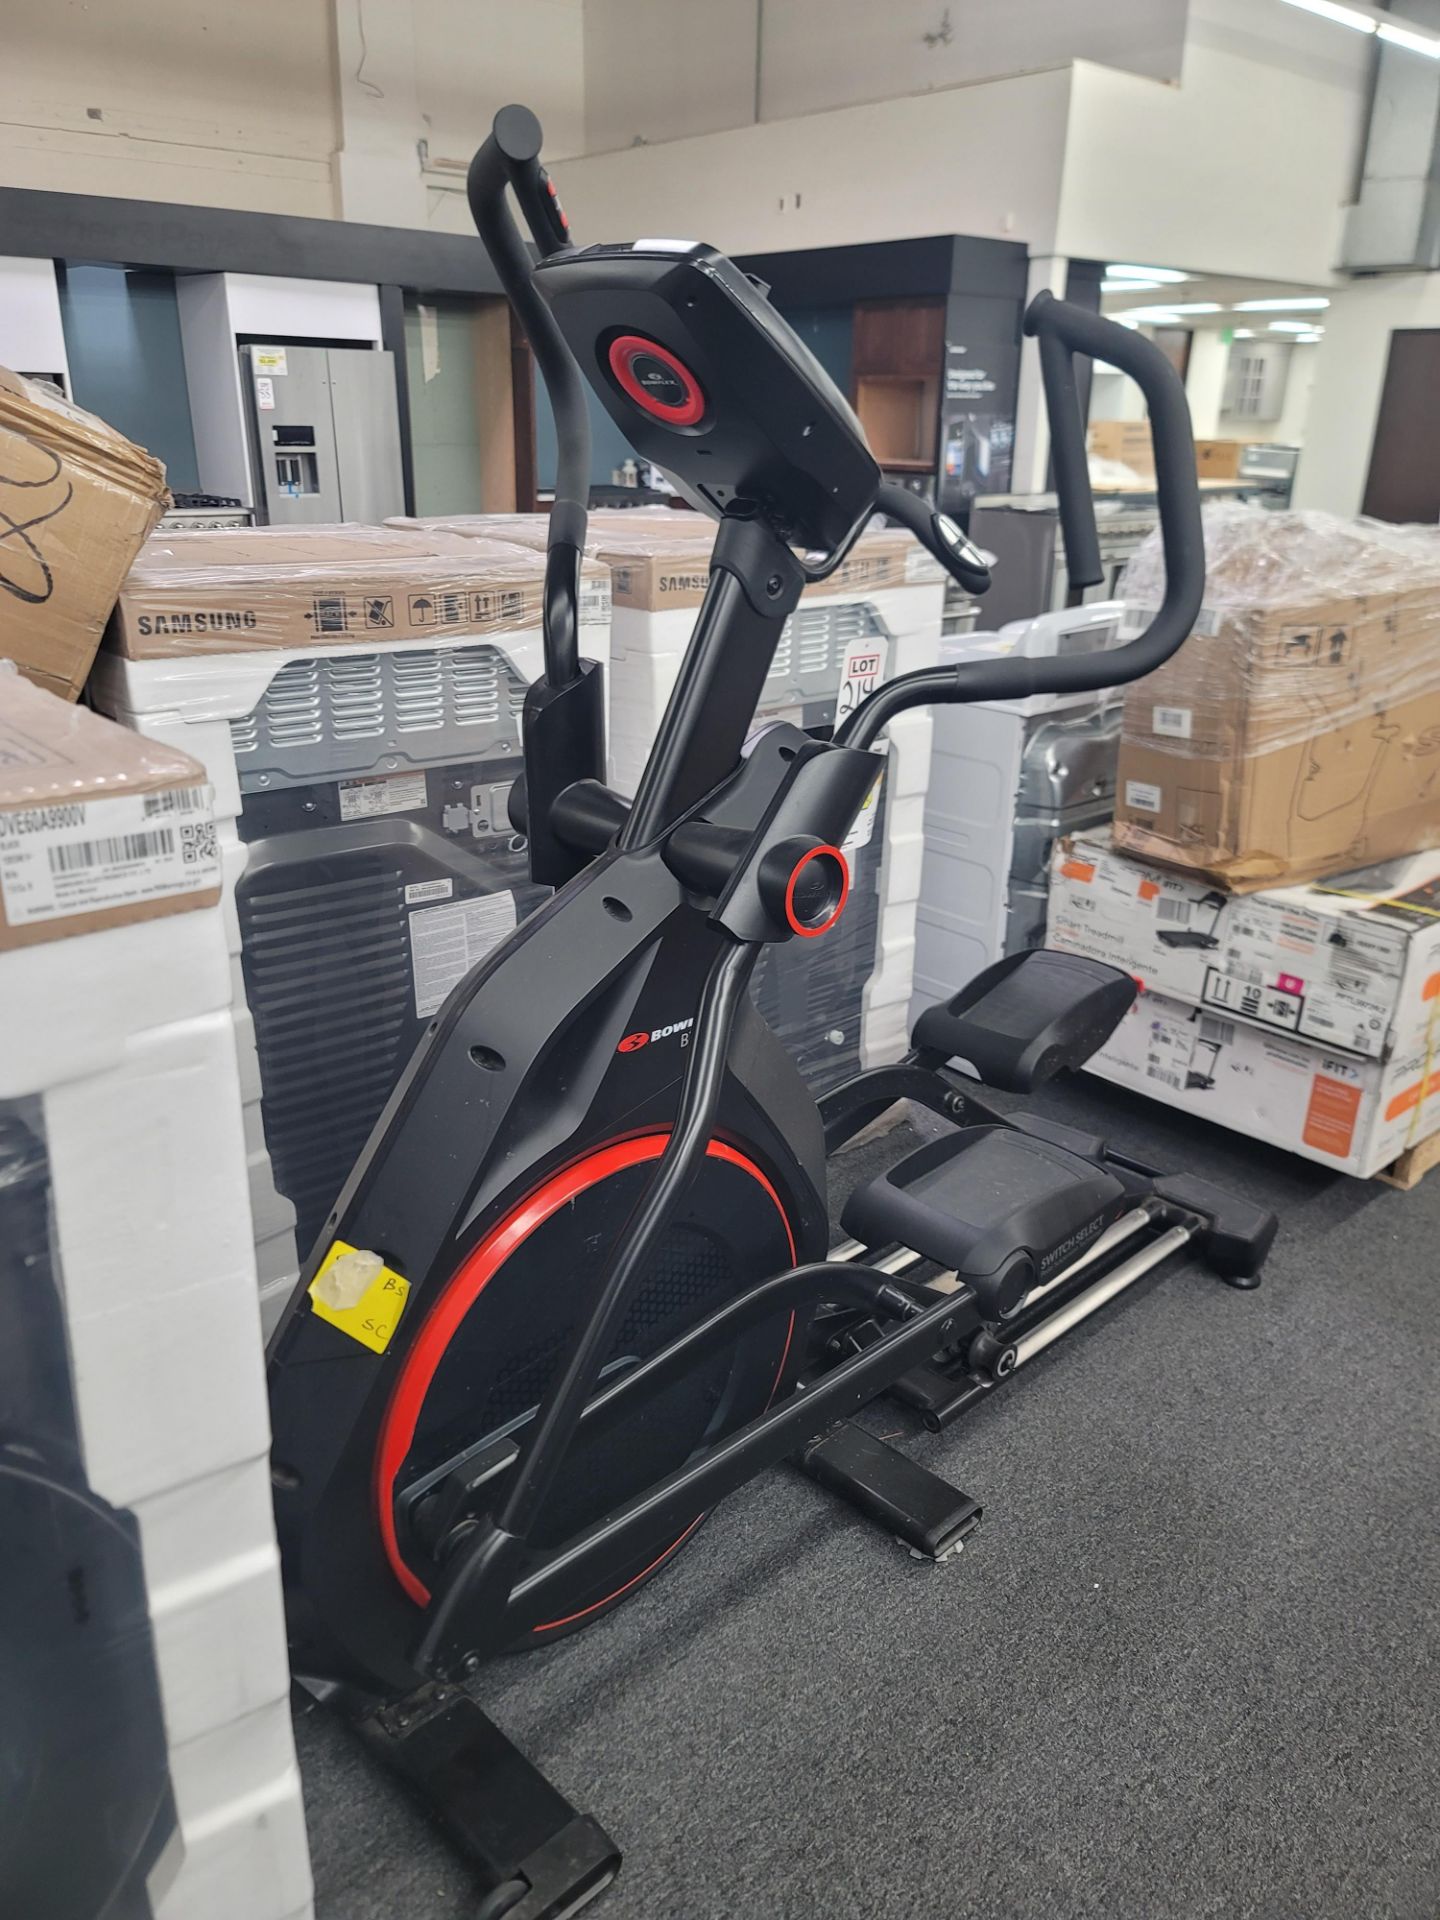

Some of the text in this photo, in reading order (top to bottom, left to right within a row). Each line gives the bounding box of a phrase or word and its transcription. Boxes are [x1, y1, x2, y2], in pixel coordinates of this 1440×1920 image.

[138, 611, 257, 636] SAMSUNG
[851, 659, 876, 673] LOT
[1244, 985, 1261, 1000] 10
[1041, 1213, 1104, 1270] SWITCH SELECT
